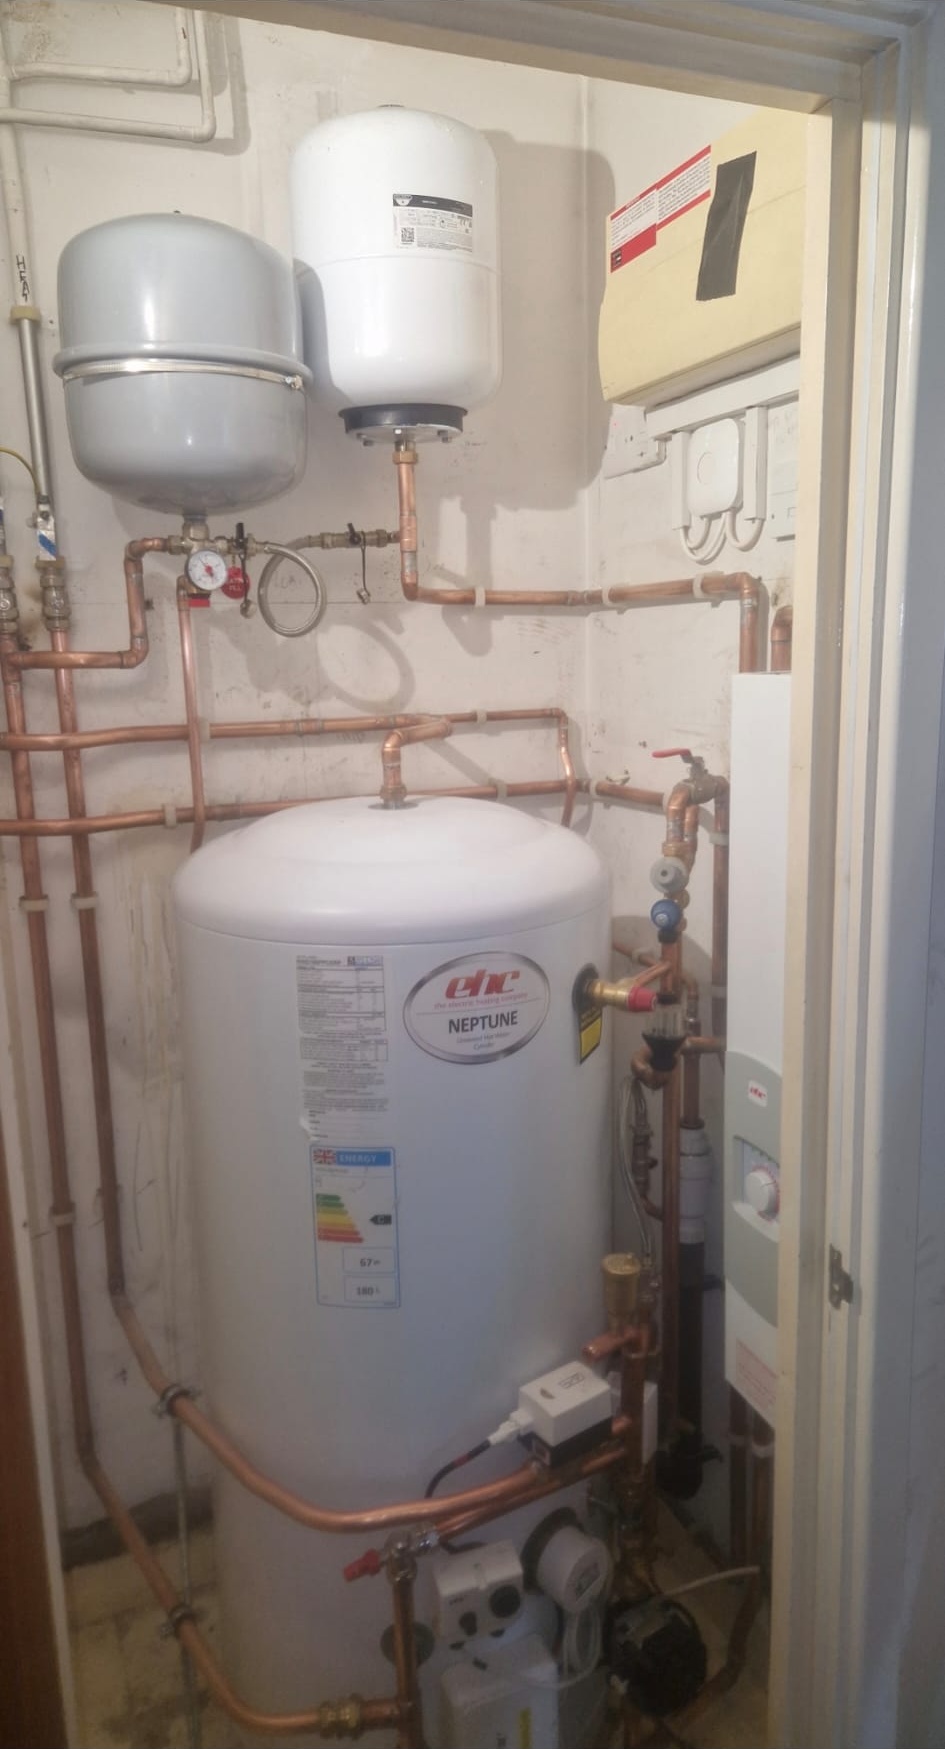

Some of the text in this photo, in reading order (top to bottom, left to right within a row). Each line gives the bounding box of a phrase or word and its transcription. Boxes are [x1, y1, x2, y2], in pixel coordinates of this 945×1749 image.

[445, 969, 521, 999] ehc
[448, 1010, 518, 1035] NEPTUNE
[339, 1154, 377, 1164] ENERGY
